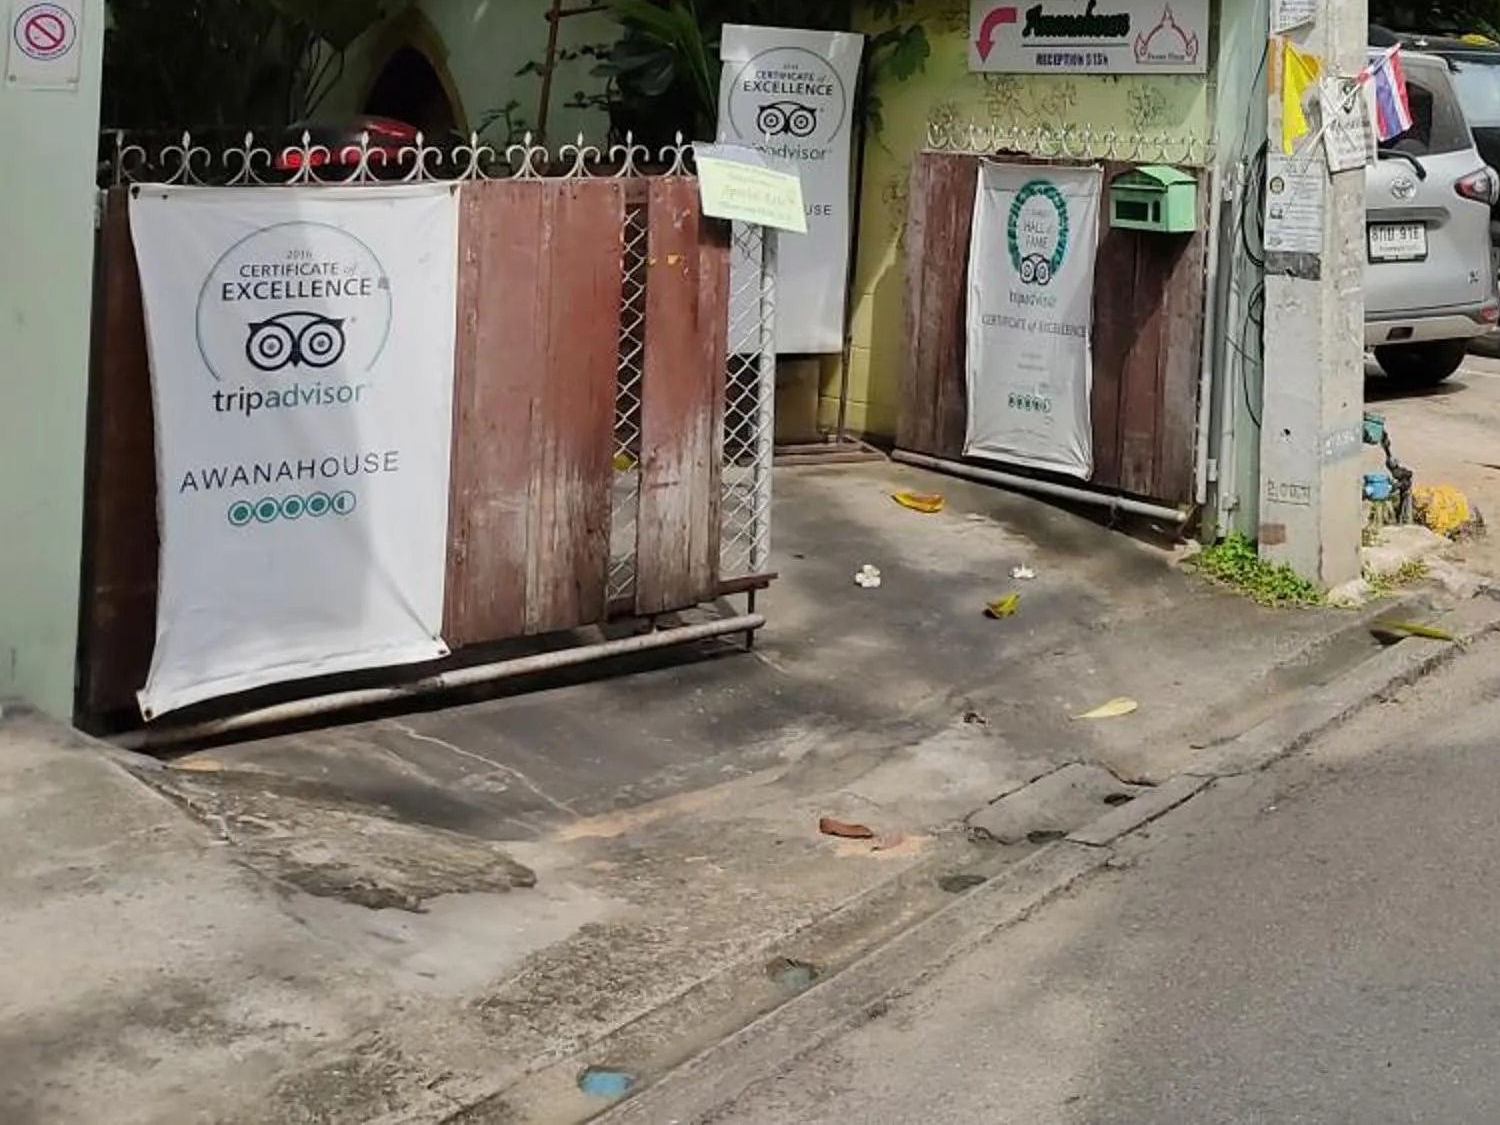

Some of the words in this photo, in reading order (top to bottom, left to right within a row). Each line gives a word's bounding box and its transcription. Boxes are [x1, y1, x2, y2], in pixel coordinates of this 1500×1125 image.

[743, 79, 833, 96] EXCELLENCE
[239, 262, 339, 278] CERTIFICATE
[222, 277, 372, 302] EXCELLENCE
[213, 383, 366, 417] tripadvisor
[179, 450, 400, 494] AWANAHOUSE
